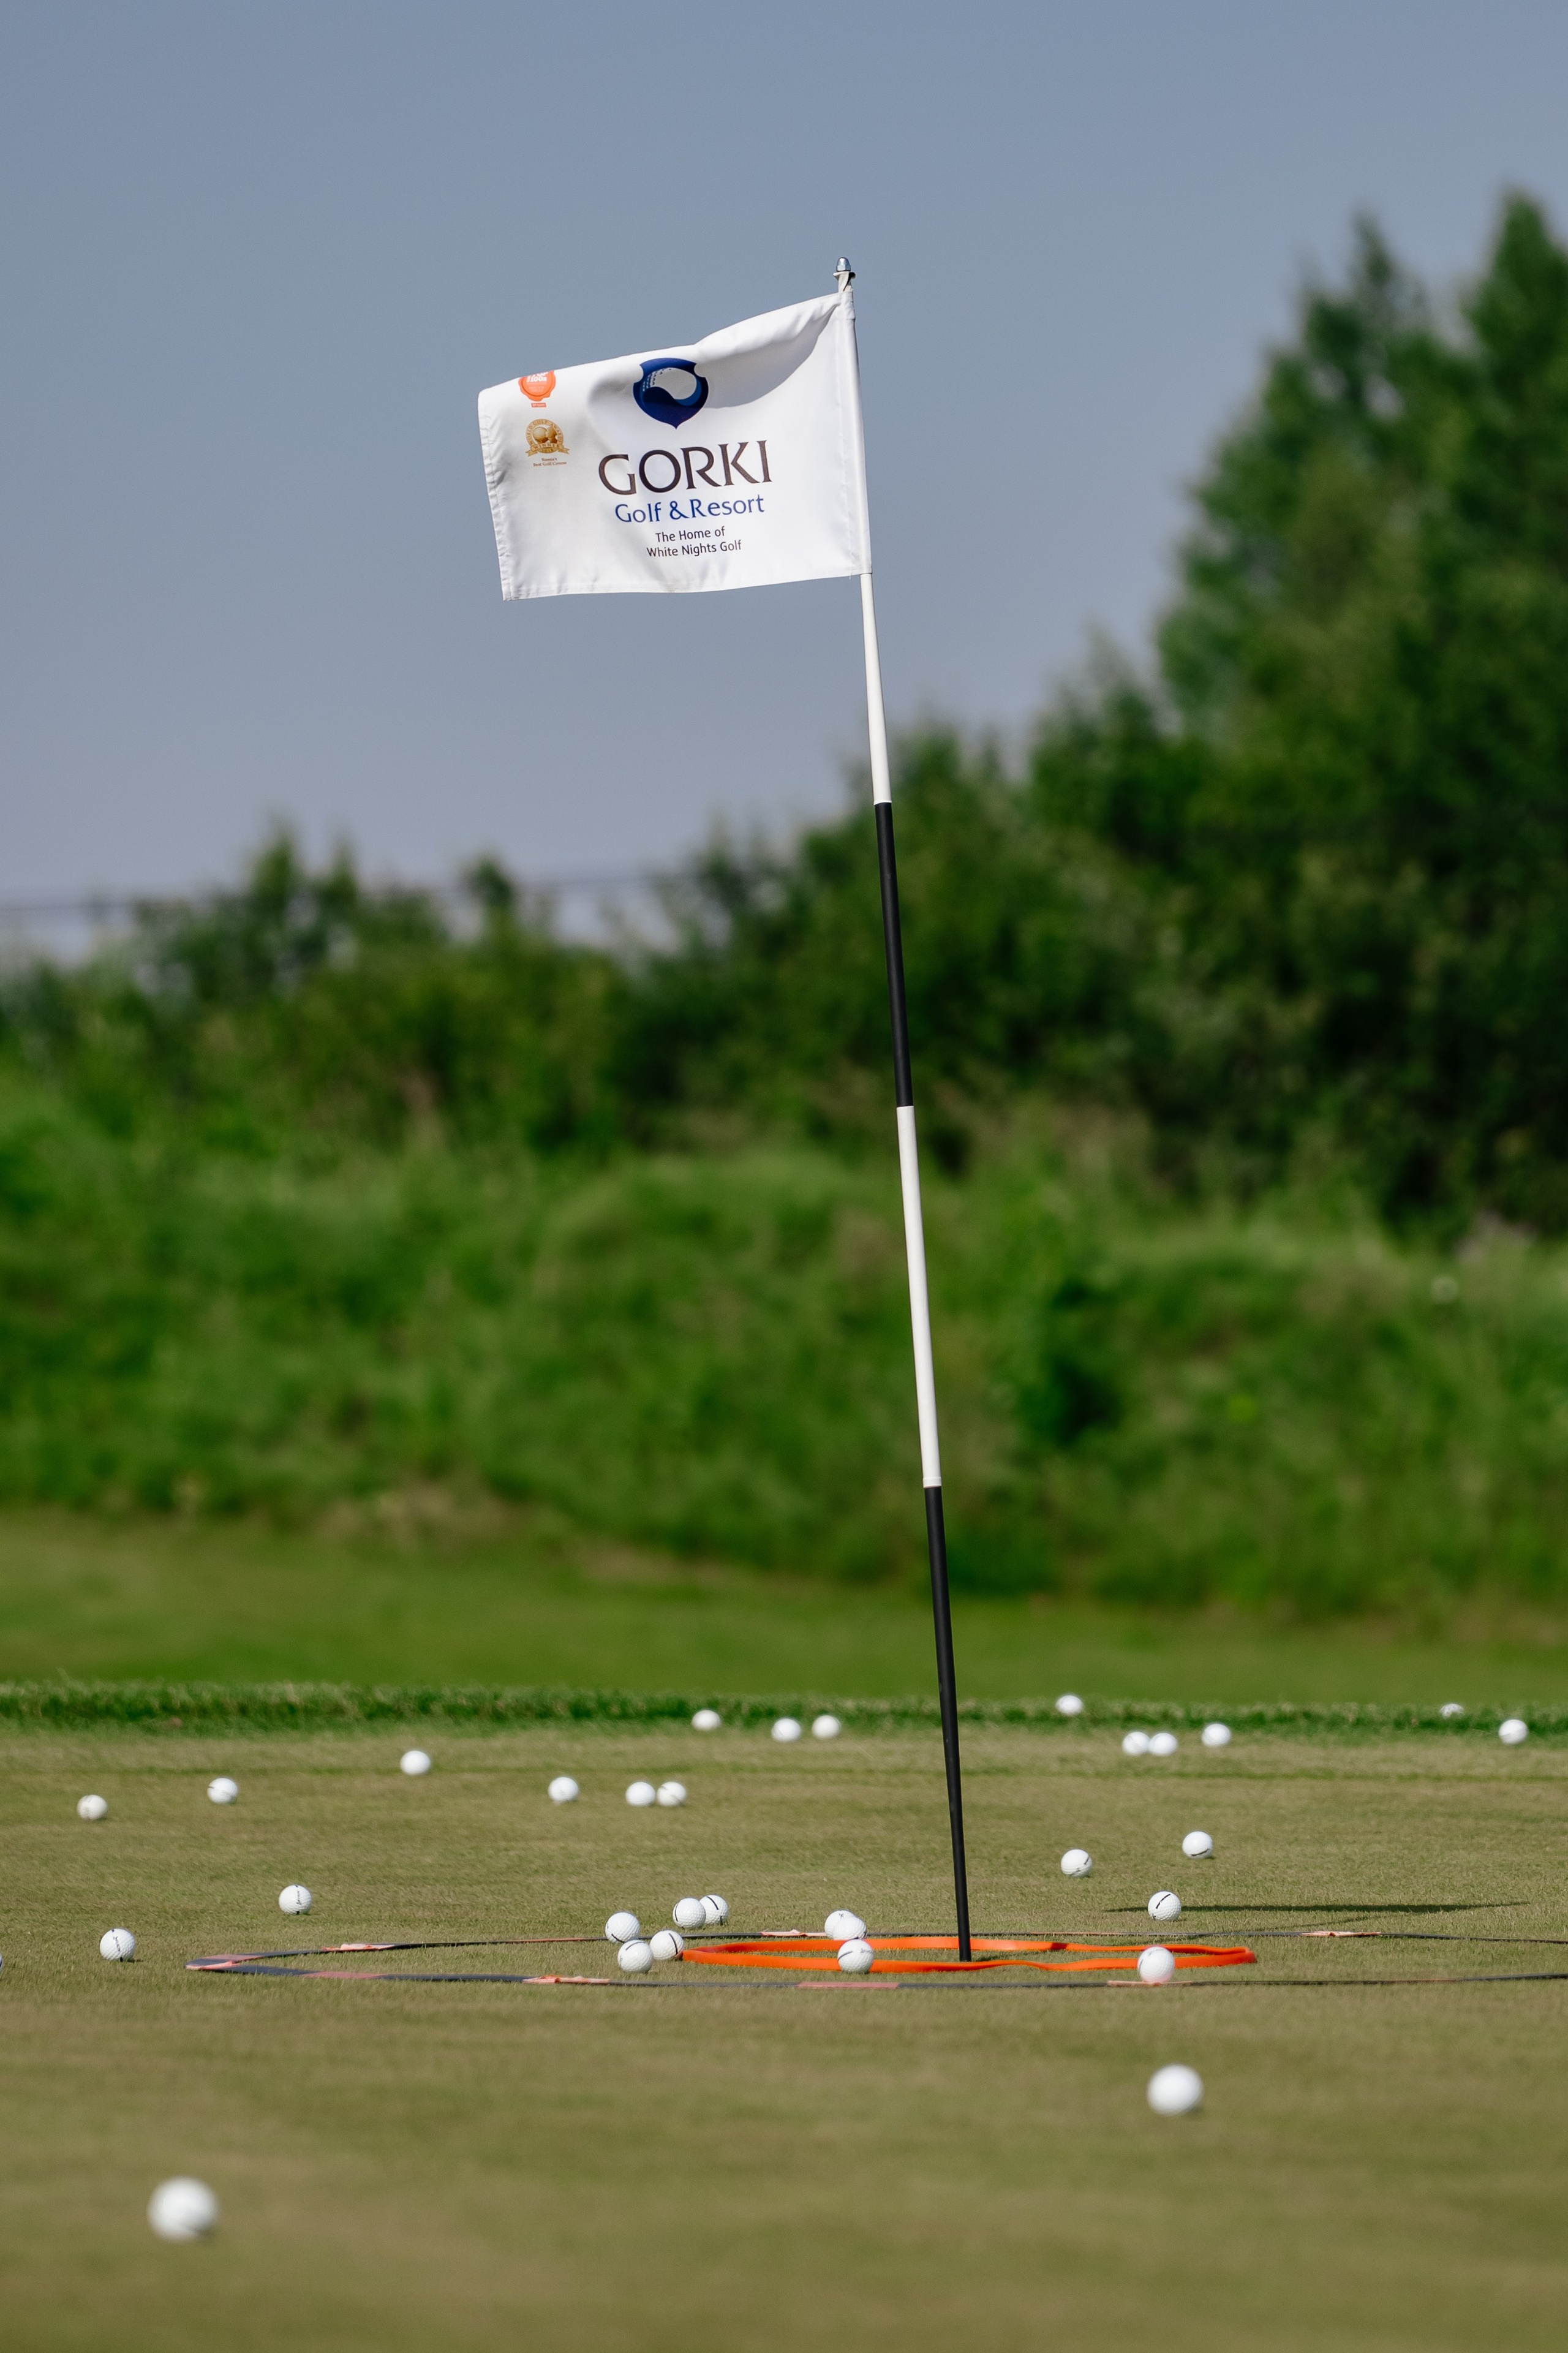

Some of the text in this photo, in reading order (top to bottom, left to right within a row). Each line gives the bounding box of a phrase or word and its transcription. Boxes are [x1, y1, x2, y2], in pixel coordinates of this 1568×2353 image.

[598, 440, 772, 495] GORKI
[615, 502, 662, 523] Golf
[655, 526, 725, 543] The Home of
[646, 540, 742, 557] White Nights Golf
